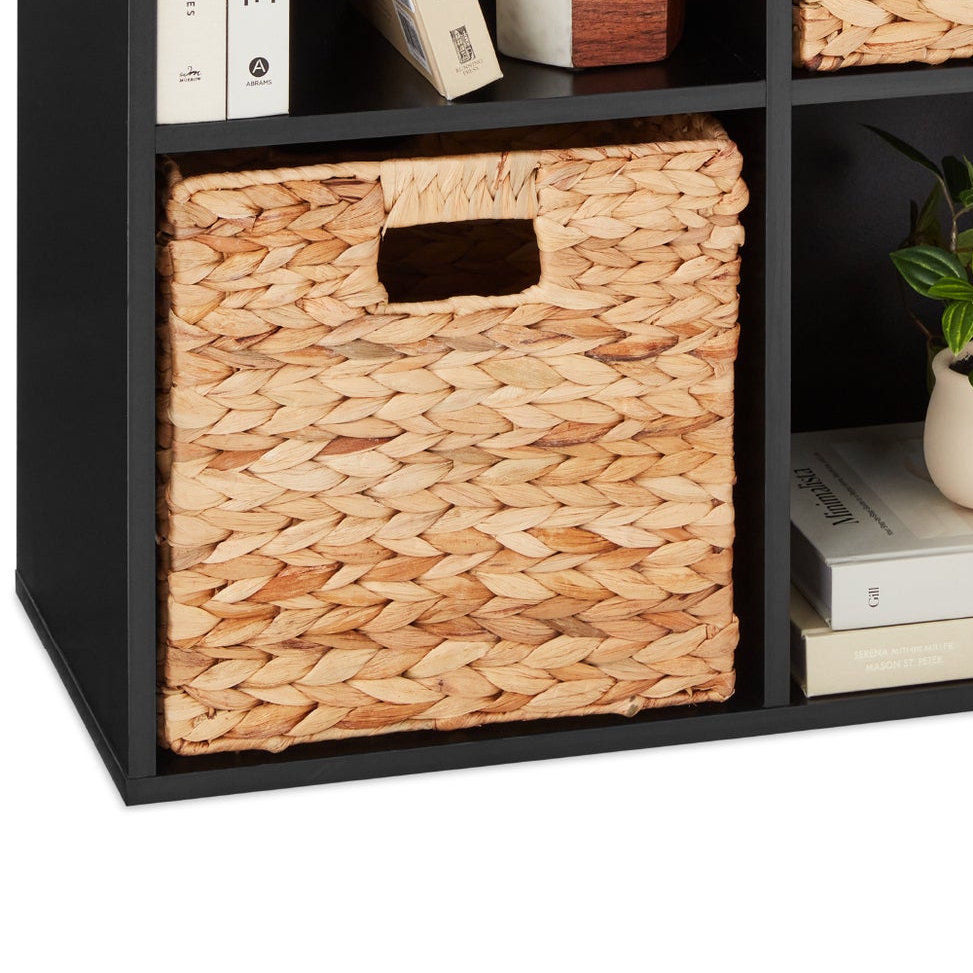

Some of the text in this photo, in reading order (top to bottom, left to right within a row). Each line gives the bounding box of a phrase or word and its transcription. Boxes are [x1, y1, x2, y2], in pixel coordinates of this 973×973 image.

[246, 79, 273, 87] ABRAMS
[793, 467, 860, 526] Minimalista
[868, 587, 880, 608] Gill
[853, 649, 889, 660] SERENA
[865, 659, 900, 672] MASON
[918, 655, 944, 667] PETER
